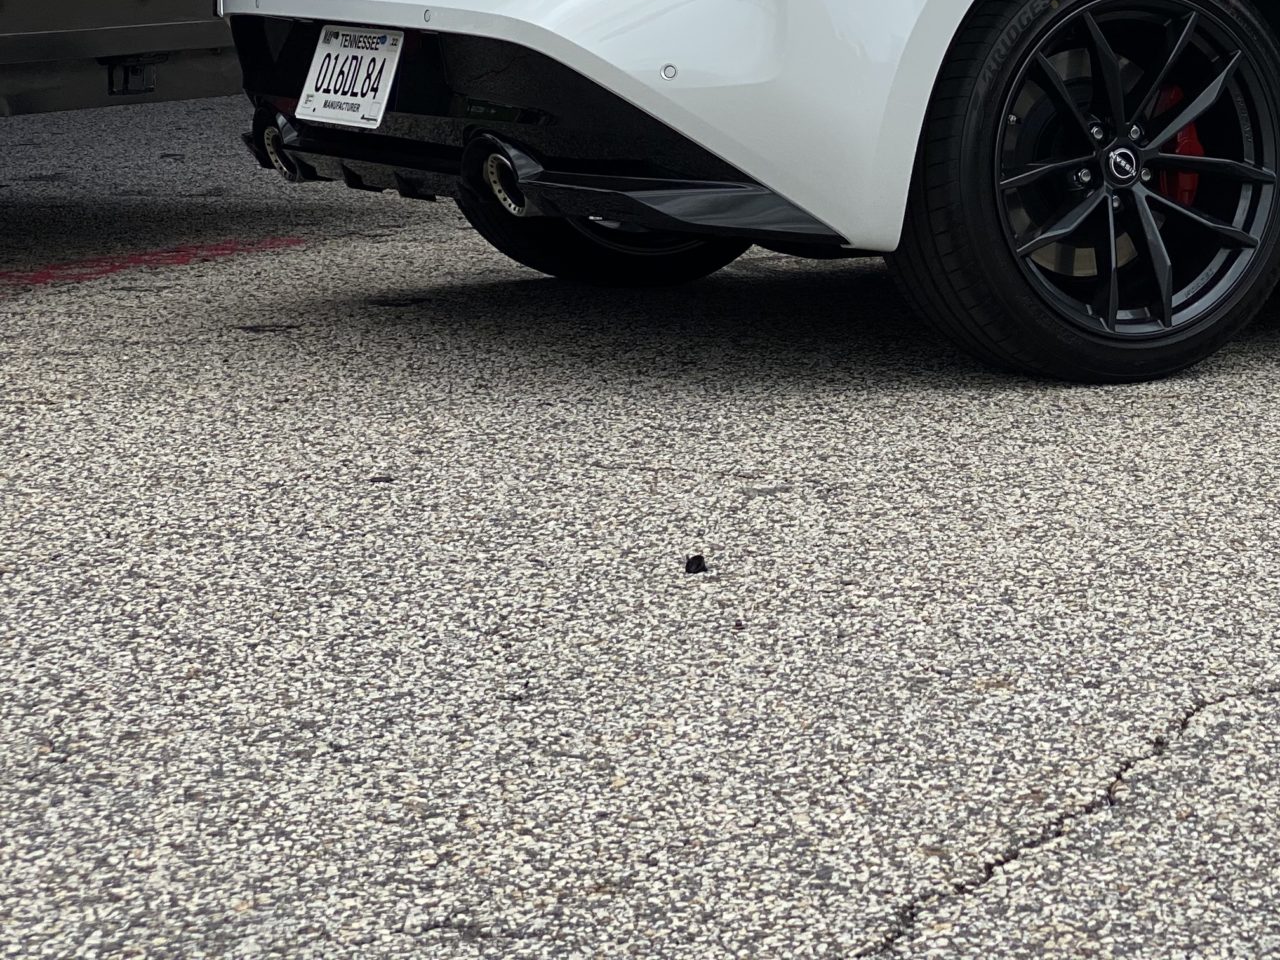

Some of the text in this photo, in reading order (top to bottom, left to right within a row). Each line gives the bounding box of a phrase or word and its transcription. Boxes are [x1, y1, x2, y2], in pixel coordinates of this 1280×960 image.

[339, 32, 381, 51] TENNESSEE
[314, 52, 387, 100] 016DL84
[322, 99, 361, 113] MANUFACTURER
